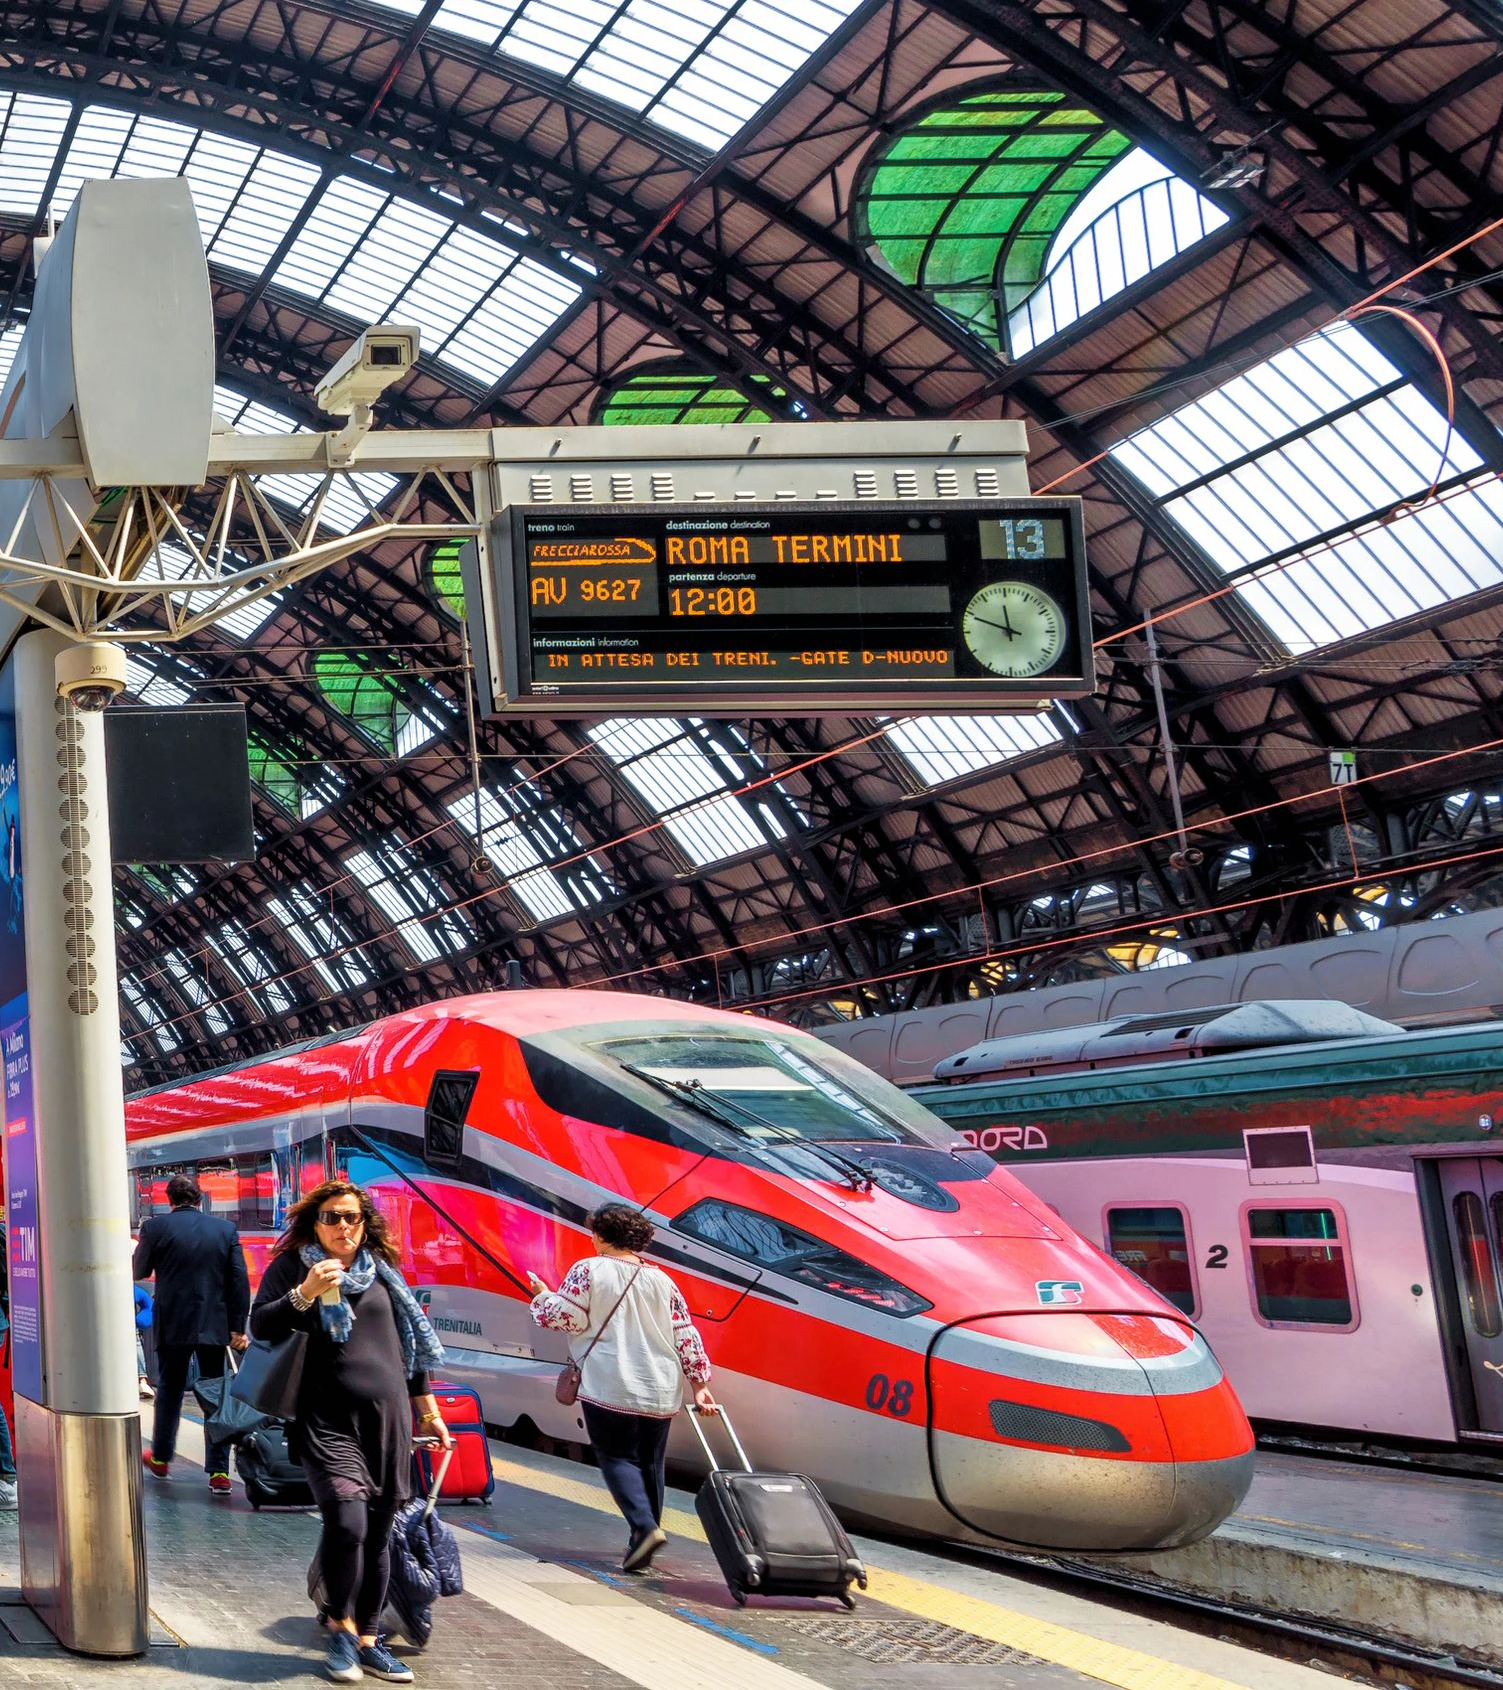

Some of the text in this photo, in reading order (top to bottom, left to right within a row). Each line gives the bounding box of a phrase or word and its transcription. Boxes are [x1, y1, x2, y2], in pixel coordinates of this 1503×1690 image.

[528, 523, 575, 532] treno train
[666, 520, 770, 530] destinazione destination
[999, 519, 1045, 559] 13
[533, 544, 631, 557] FRECCIAROSSA
[667, 534, 903, 565] ROMA TERMINI
[669, 571, 756, 583] partenza departure
[531, 576, 641, 605] AV 9627
[671, 587, 756, 616] 12:00
[533, 637, 639, 648] informazioni information
[548, 654, 569, 668] IN
[580, 653, 654, 667] ATTESA
[666, 653, 700, 666] DEI
[712, 652, 777, 666] TRENI.
[862, 649, 948, 665] D-NUOVO
[1332, 763, 1353, 783] 7T
[19, 1226, 36, 1262] TIM
[1205, 1244, 1229, 1269] 2
[432, 1317, 483, 1337] TRENITALIA
[865, 1373, 914, 1417] 08
